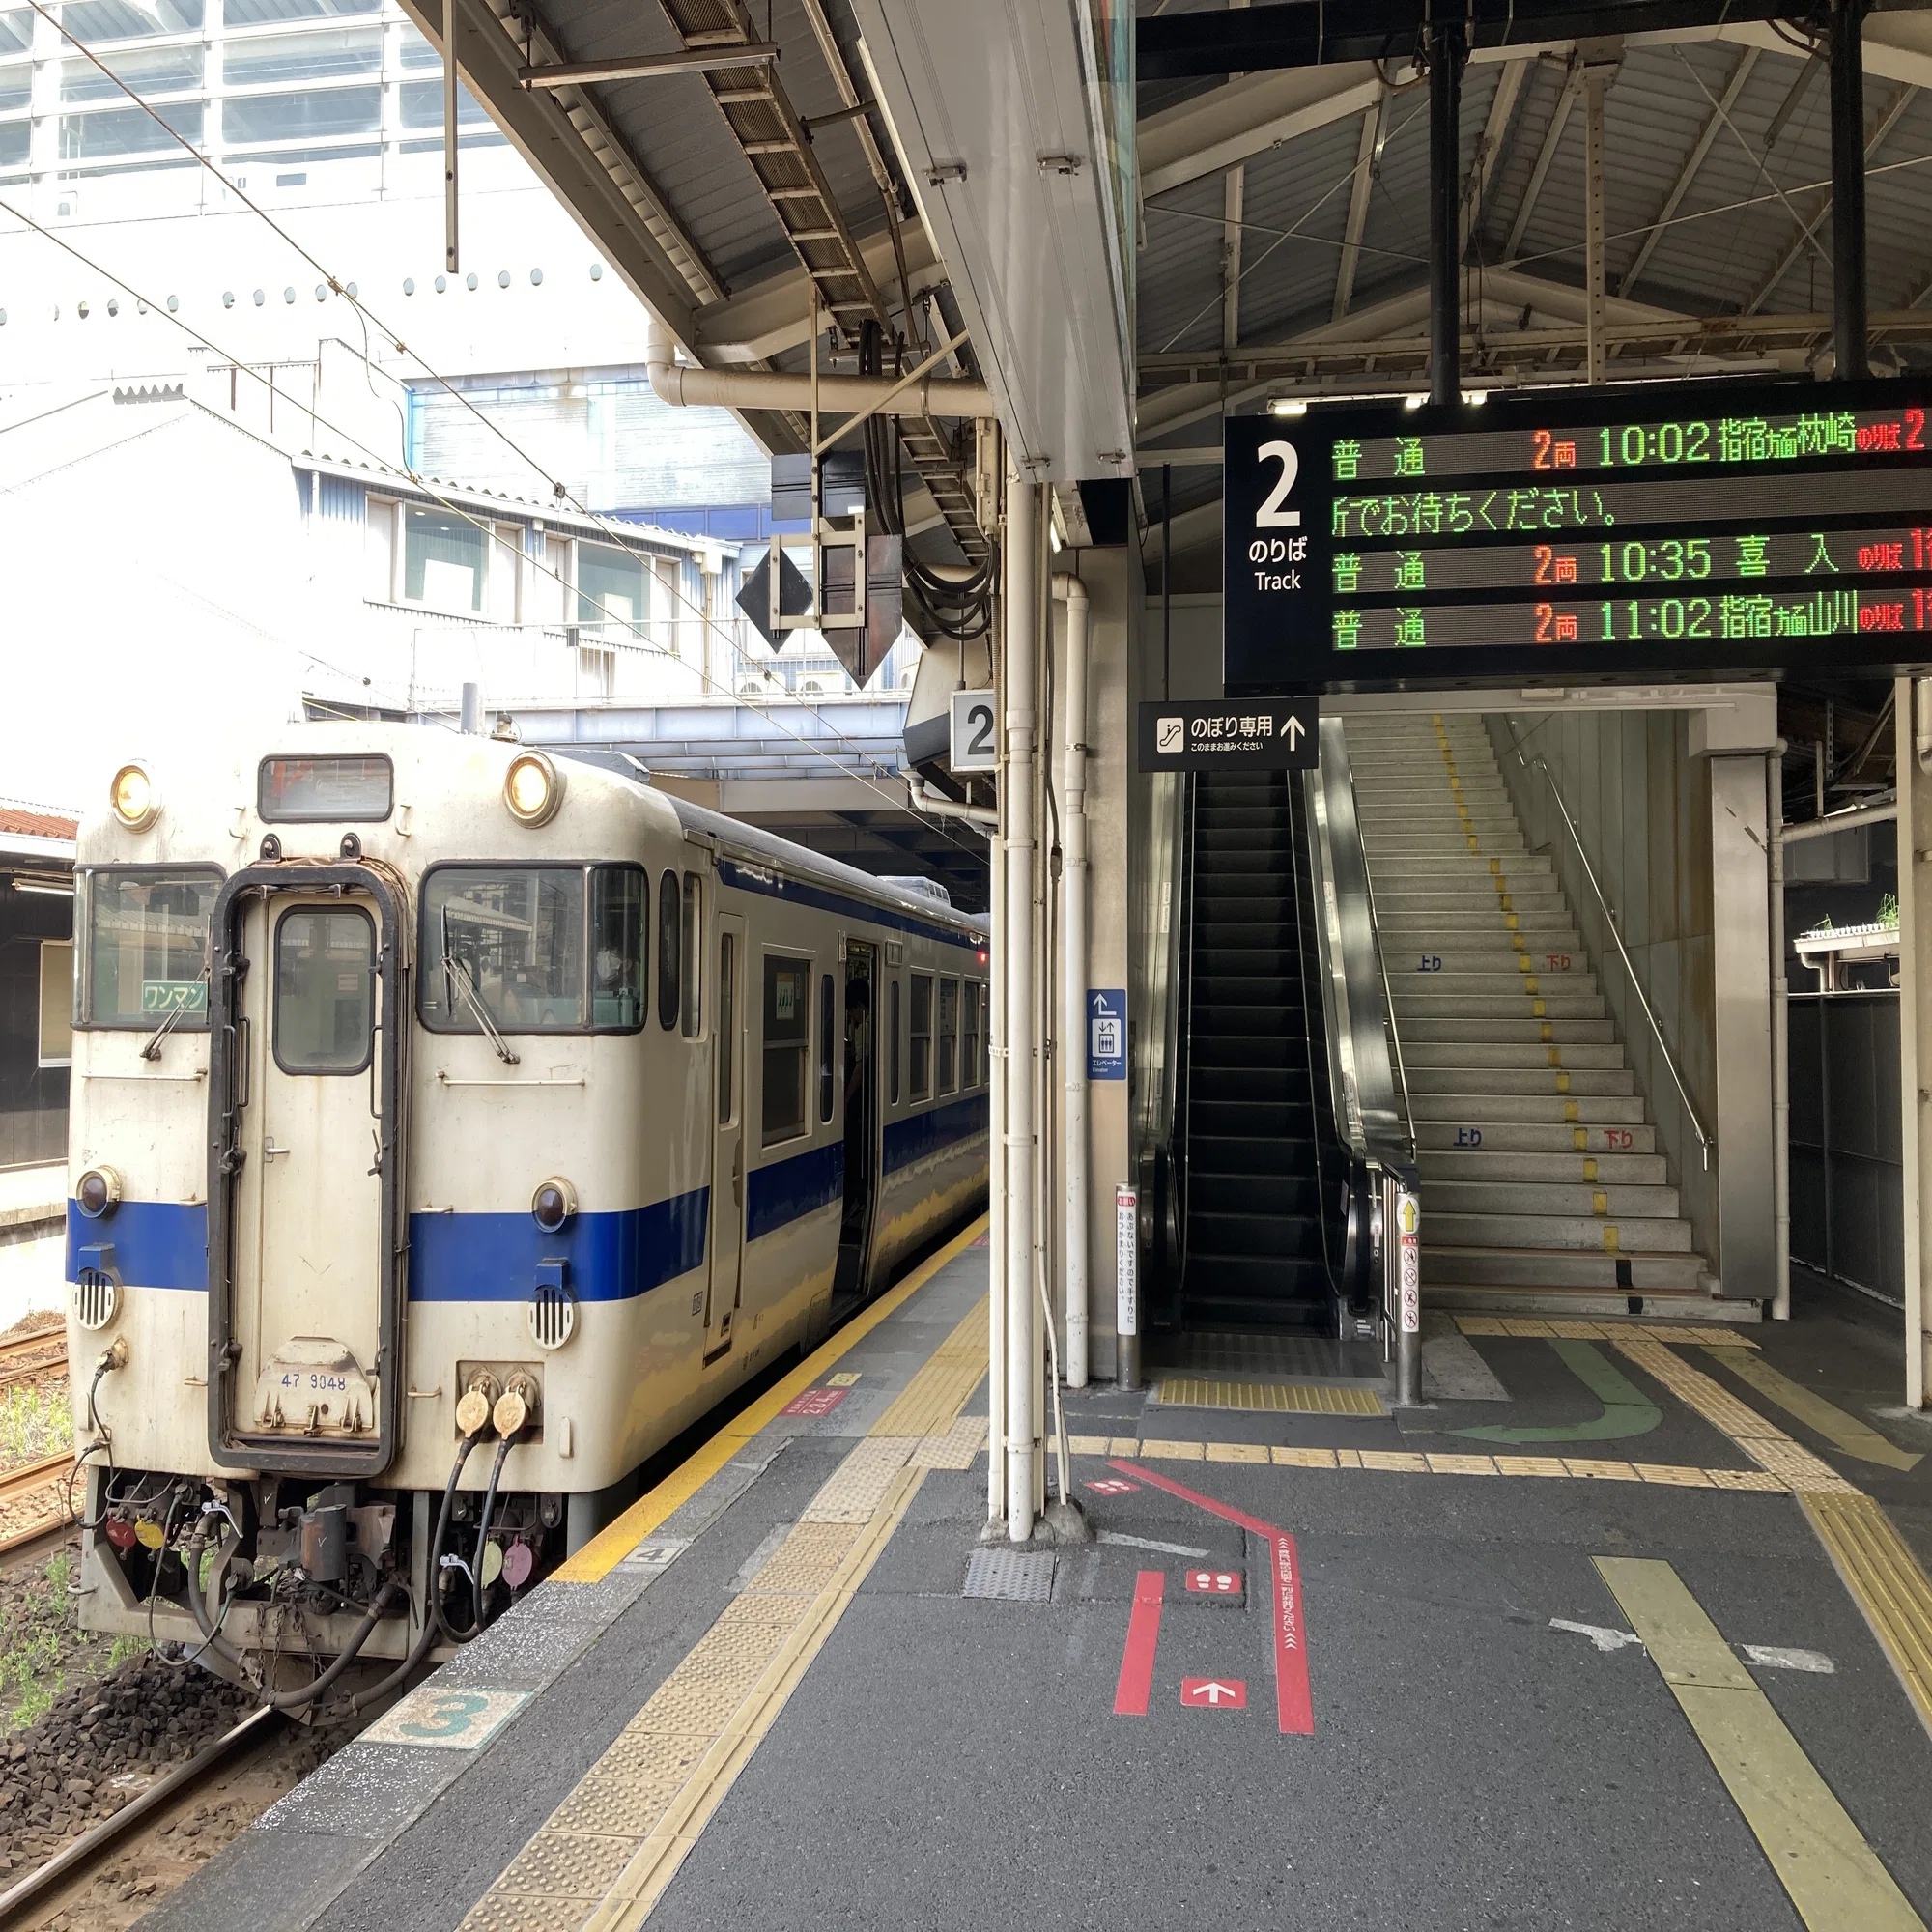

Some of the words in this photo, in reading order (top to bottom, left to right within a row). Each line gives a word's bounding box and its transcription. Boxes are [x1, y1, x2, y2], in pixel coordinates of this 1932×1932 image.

[1332, 437, 1426, 478] 普通
[1532, 429, 1576, 469] 2両
[1600, 423, 1710, 466] 10:02
[1256, 440, 1301, 528] 2
[1249, 535, 1308, 563] のりば
[1332, 551, 1426, 592] 普通
[1534, 545, 1577, 584] 2両
[1601, 540, 1711, 582] 10:35
[1255, 569, 1302, 591] Track
[1332, 607, 1427, 648] 普通
[1534, 602, 1577, 642] 2両
[1601, 598, 1712, 639] 11:02
[967, 704, 994, 755] 2
[1191, 716, 1273, 738] のぼり専用
[1190, 741, 1264, 752] このままお進みください
[1417, 955, 1442, 972] 上り
[1547, 954, 1571, 972] 下り
[145, 985, 204, 1009] ワンマン
[1453, 1127, 1482, 1147] 上り
[1604, 1130, 1634, 1149] 下り
[281, 1373, 300, 1387] 47
[310, 1374, 346, 1391] 9048
[636, 1548, 667, 1561] 4
[398, 1694, 489, 1737] 3
